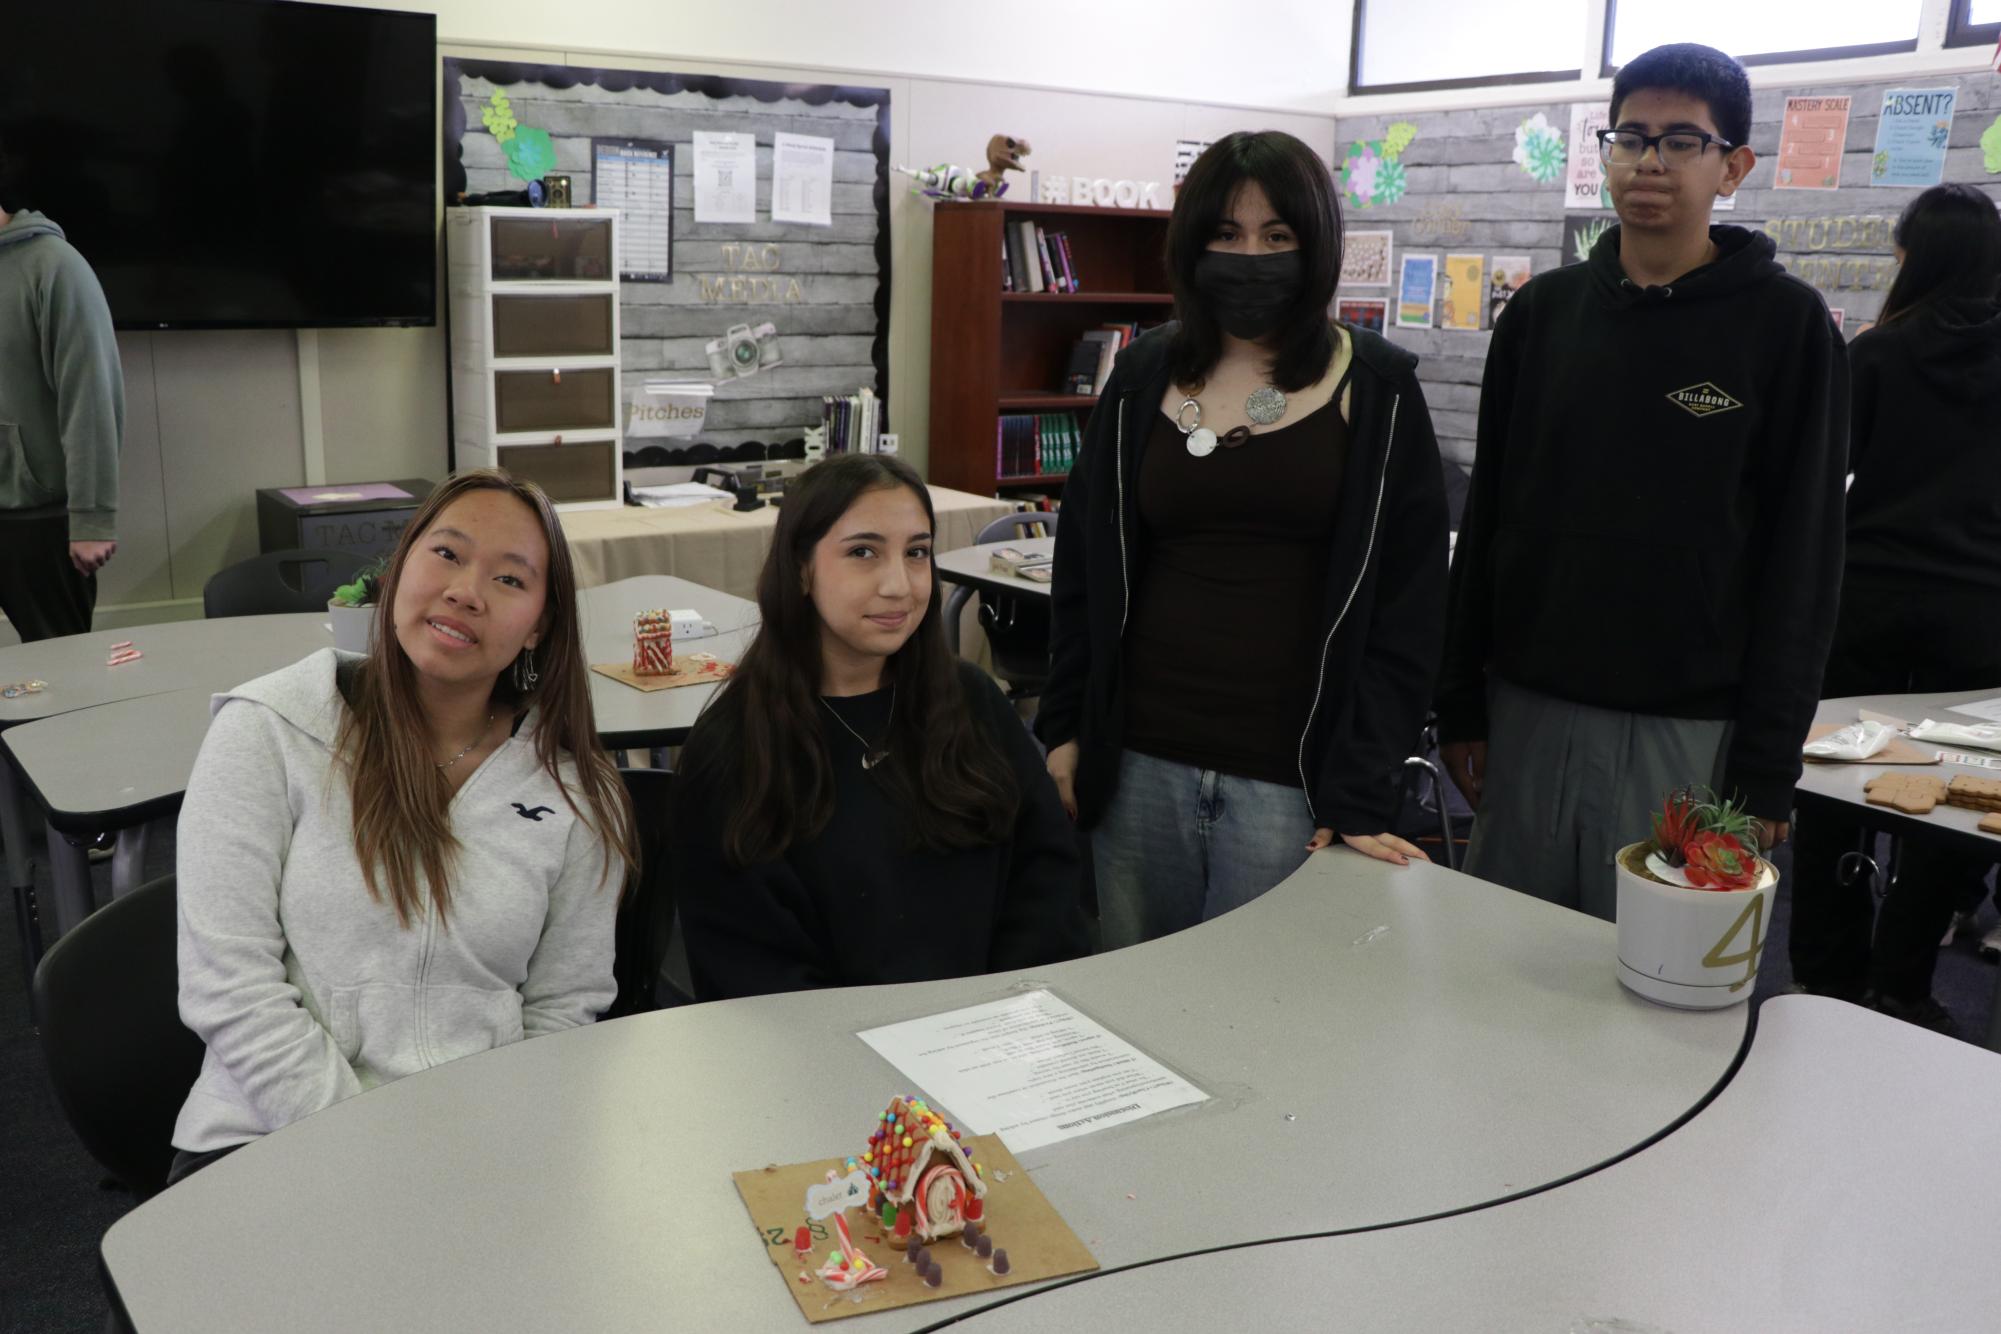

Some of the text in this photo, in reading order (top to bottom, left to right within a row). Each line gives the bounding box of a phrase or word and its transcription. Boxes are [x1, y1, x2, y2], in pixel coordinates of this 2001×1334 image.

[1787, 97, 1851, 112] MASTERY SCALE
[1882, 93, 1953, 116] ABSENT?
[1579, 142, 1599, 154] but
[1581, 157, 1595, 167] so
[1576, 169, 1597, 180] are
[1574, 183, 1599, 196] YOU
[721, 242, 781, 272] TAC
[698, 274, 801, 304] MEDIA
[1678, 392, 1730, 407] BILLABONG
[630, 402, 704, 421] Pitches
[314, 521, 376, 545] TAC
[1702, 893, 1767, 992] 4
